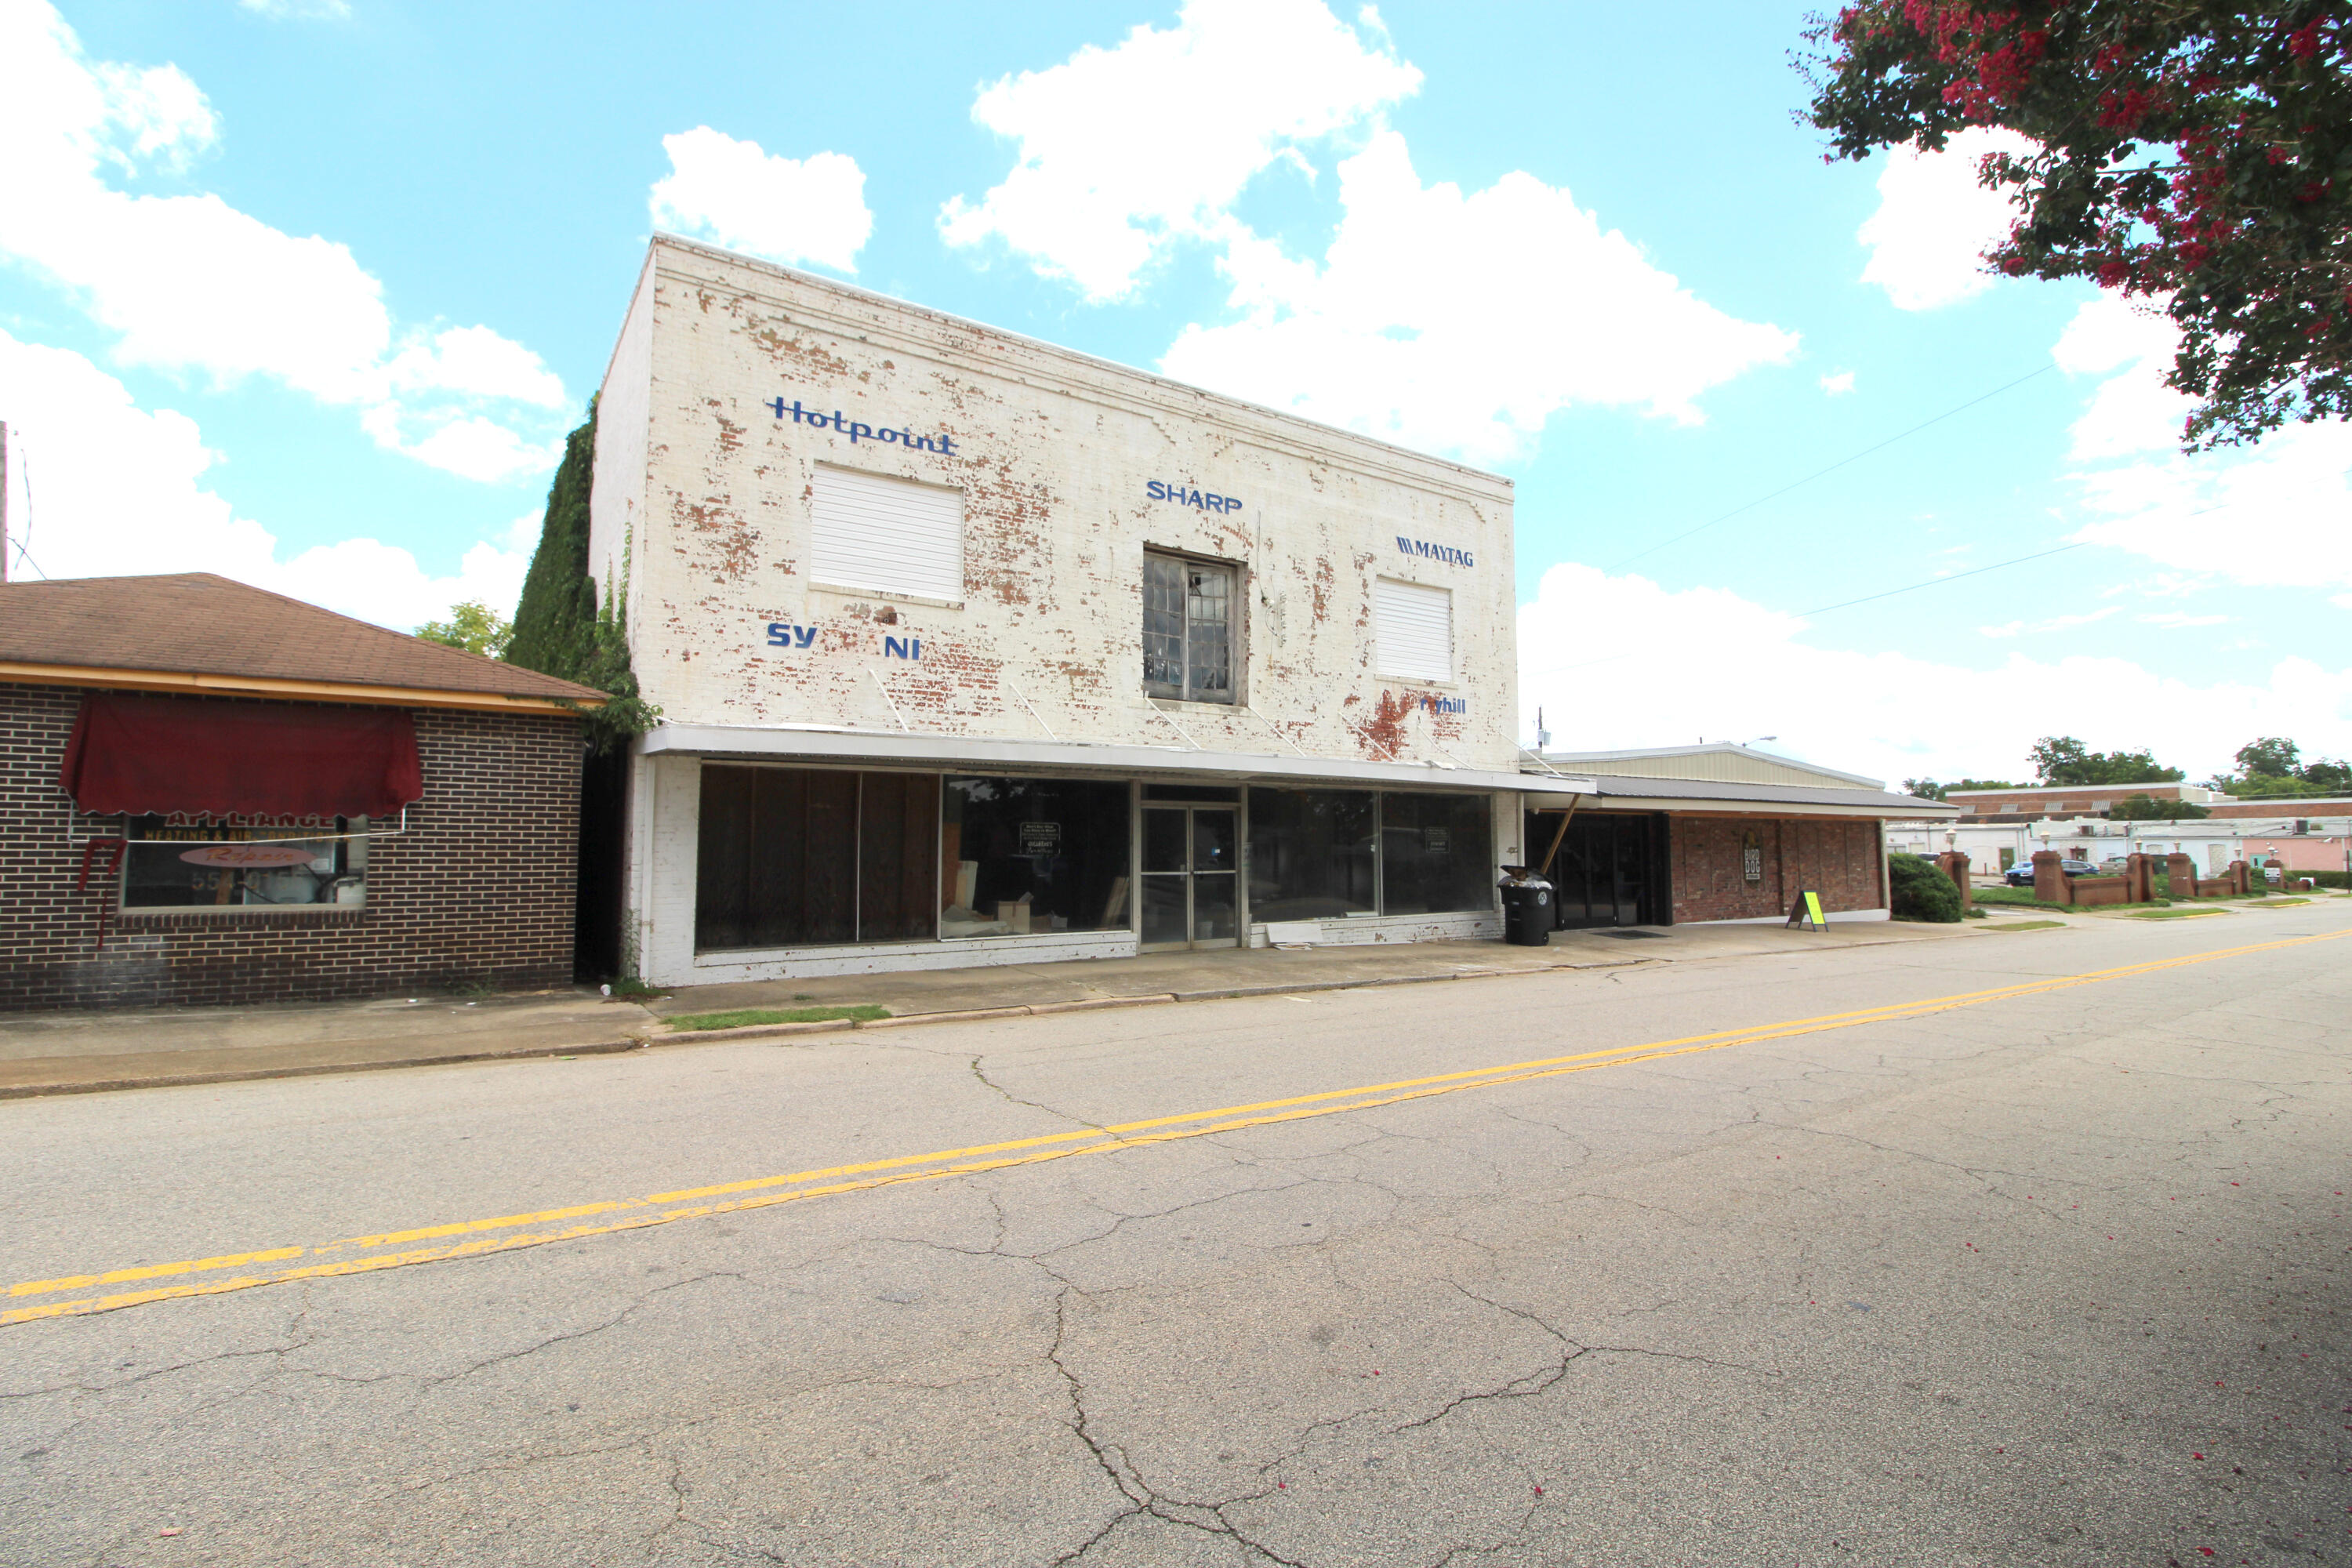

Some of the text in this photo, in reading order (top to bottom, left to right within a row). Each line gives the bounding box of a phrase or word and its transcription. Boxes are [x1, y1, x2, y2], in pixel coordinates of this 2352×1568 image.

[765, 396, 960, 456] Hotpoint
[1146, 481, 1243, 514] SHARP
[1415, 539, 1473, 568] MAYTAG
[164, 811, 336, 829] APPLIANCE
[144, 829, 209, 841] HEATING
[213, 829, 223, 841] &
[206, 848, 293, 864] Repair
[1744, 849, 1760, 861] BIRD
[1745, 860, 1761, 873] DOG
